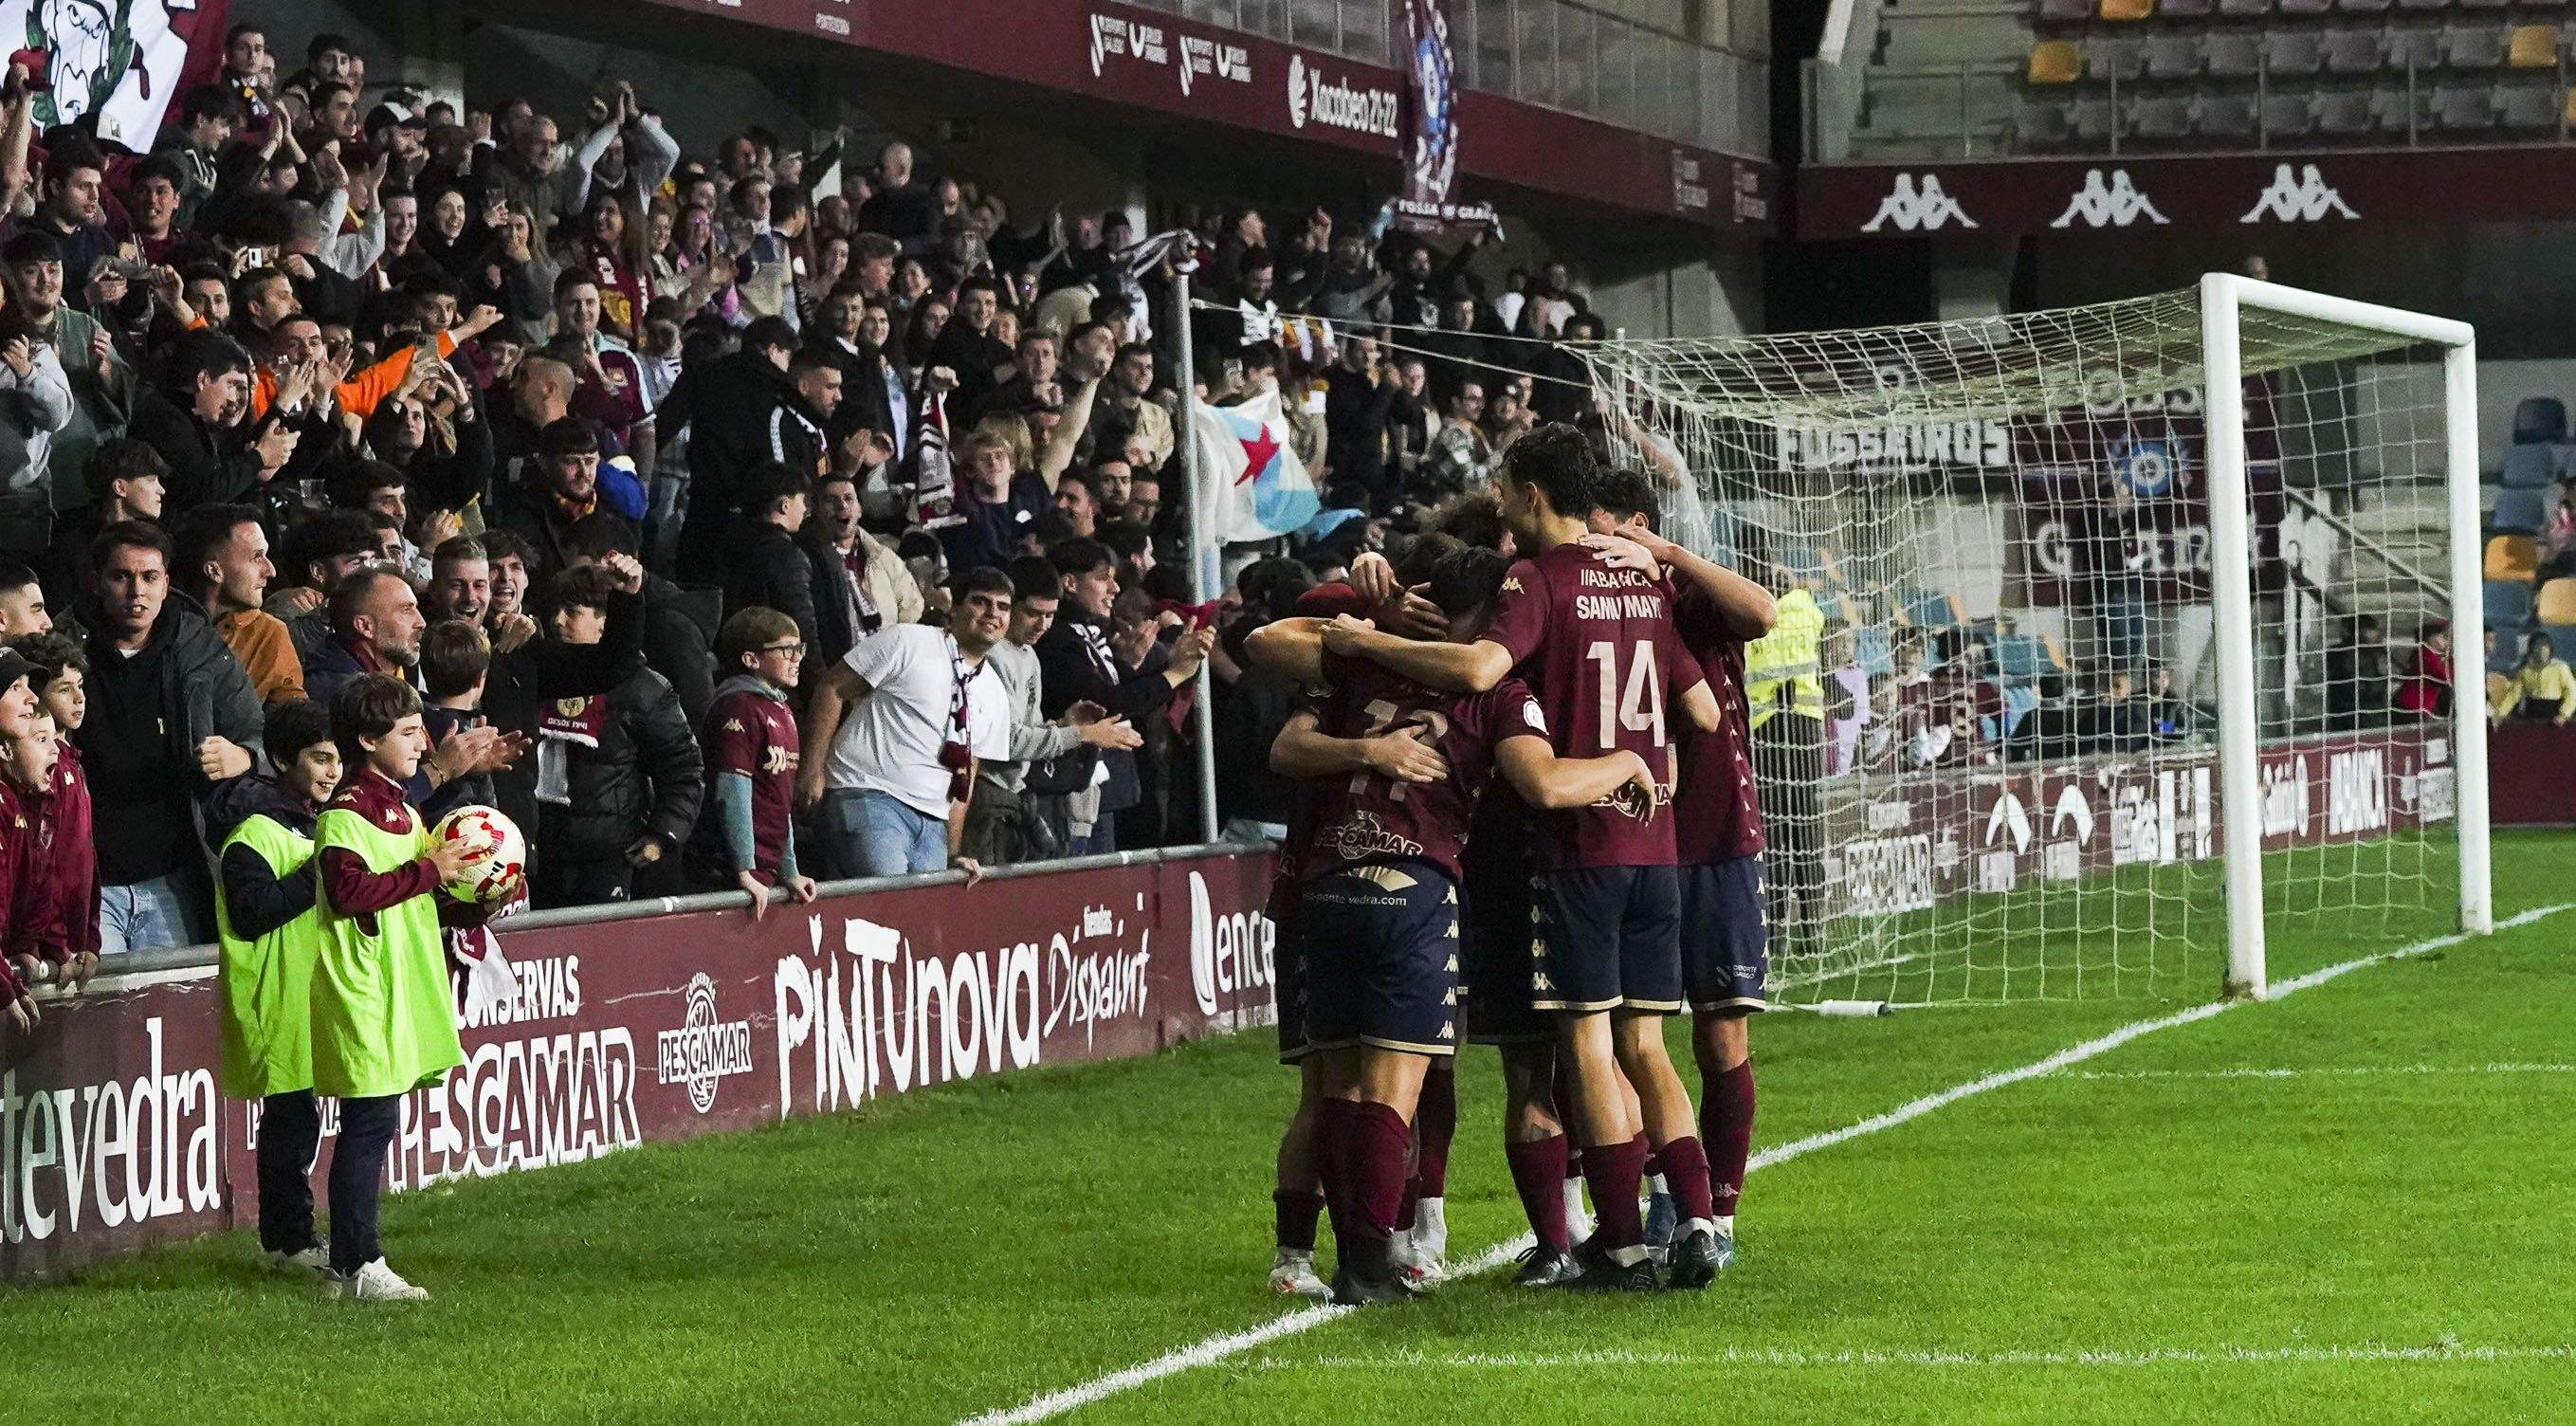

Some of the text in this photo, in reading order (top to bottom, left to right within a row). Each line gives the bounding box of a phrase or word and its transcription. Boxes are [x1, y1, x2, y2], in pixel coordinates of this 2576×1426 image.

[1576, 594, 1622, 620] SAMU
[1586, 639, 1666, 749] 14
[658, 1019, 754, 1085] PESCAMAR
[0, 1016, 221, 1244] tevedra
[387, 1026, 643, 1196] PESCAMAR
